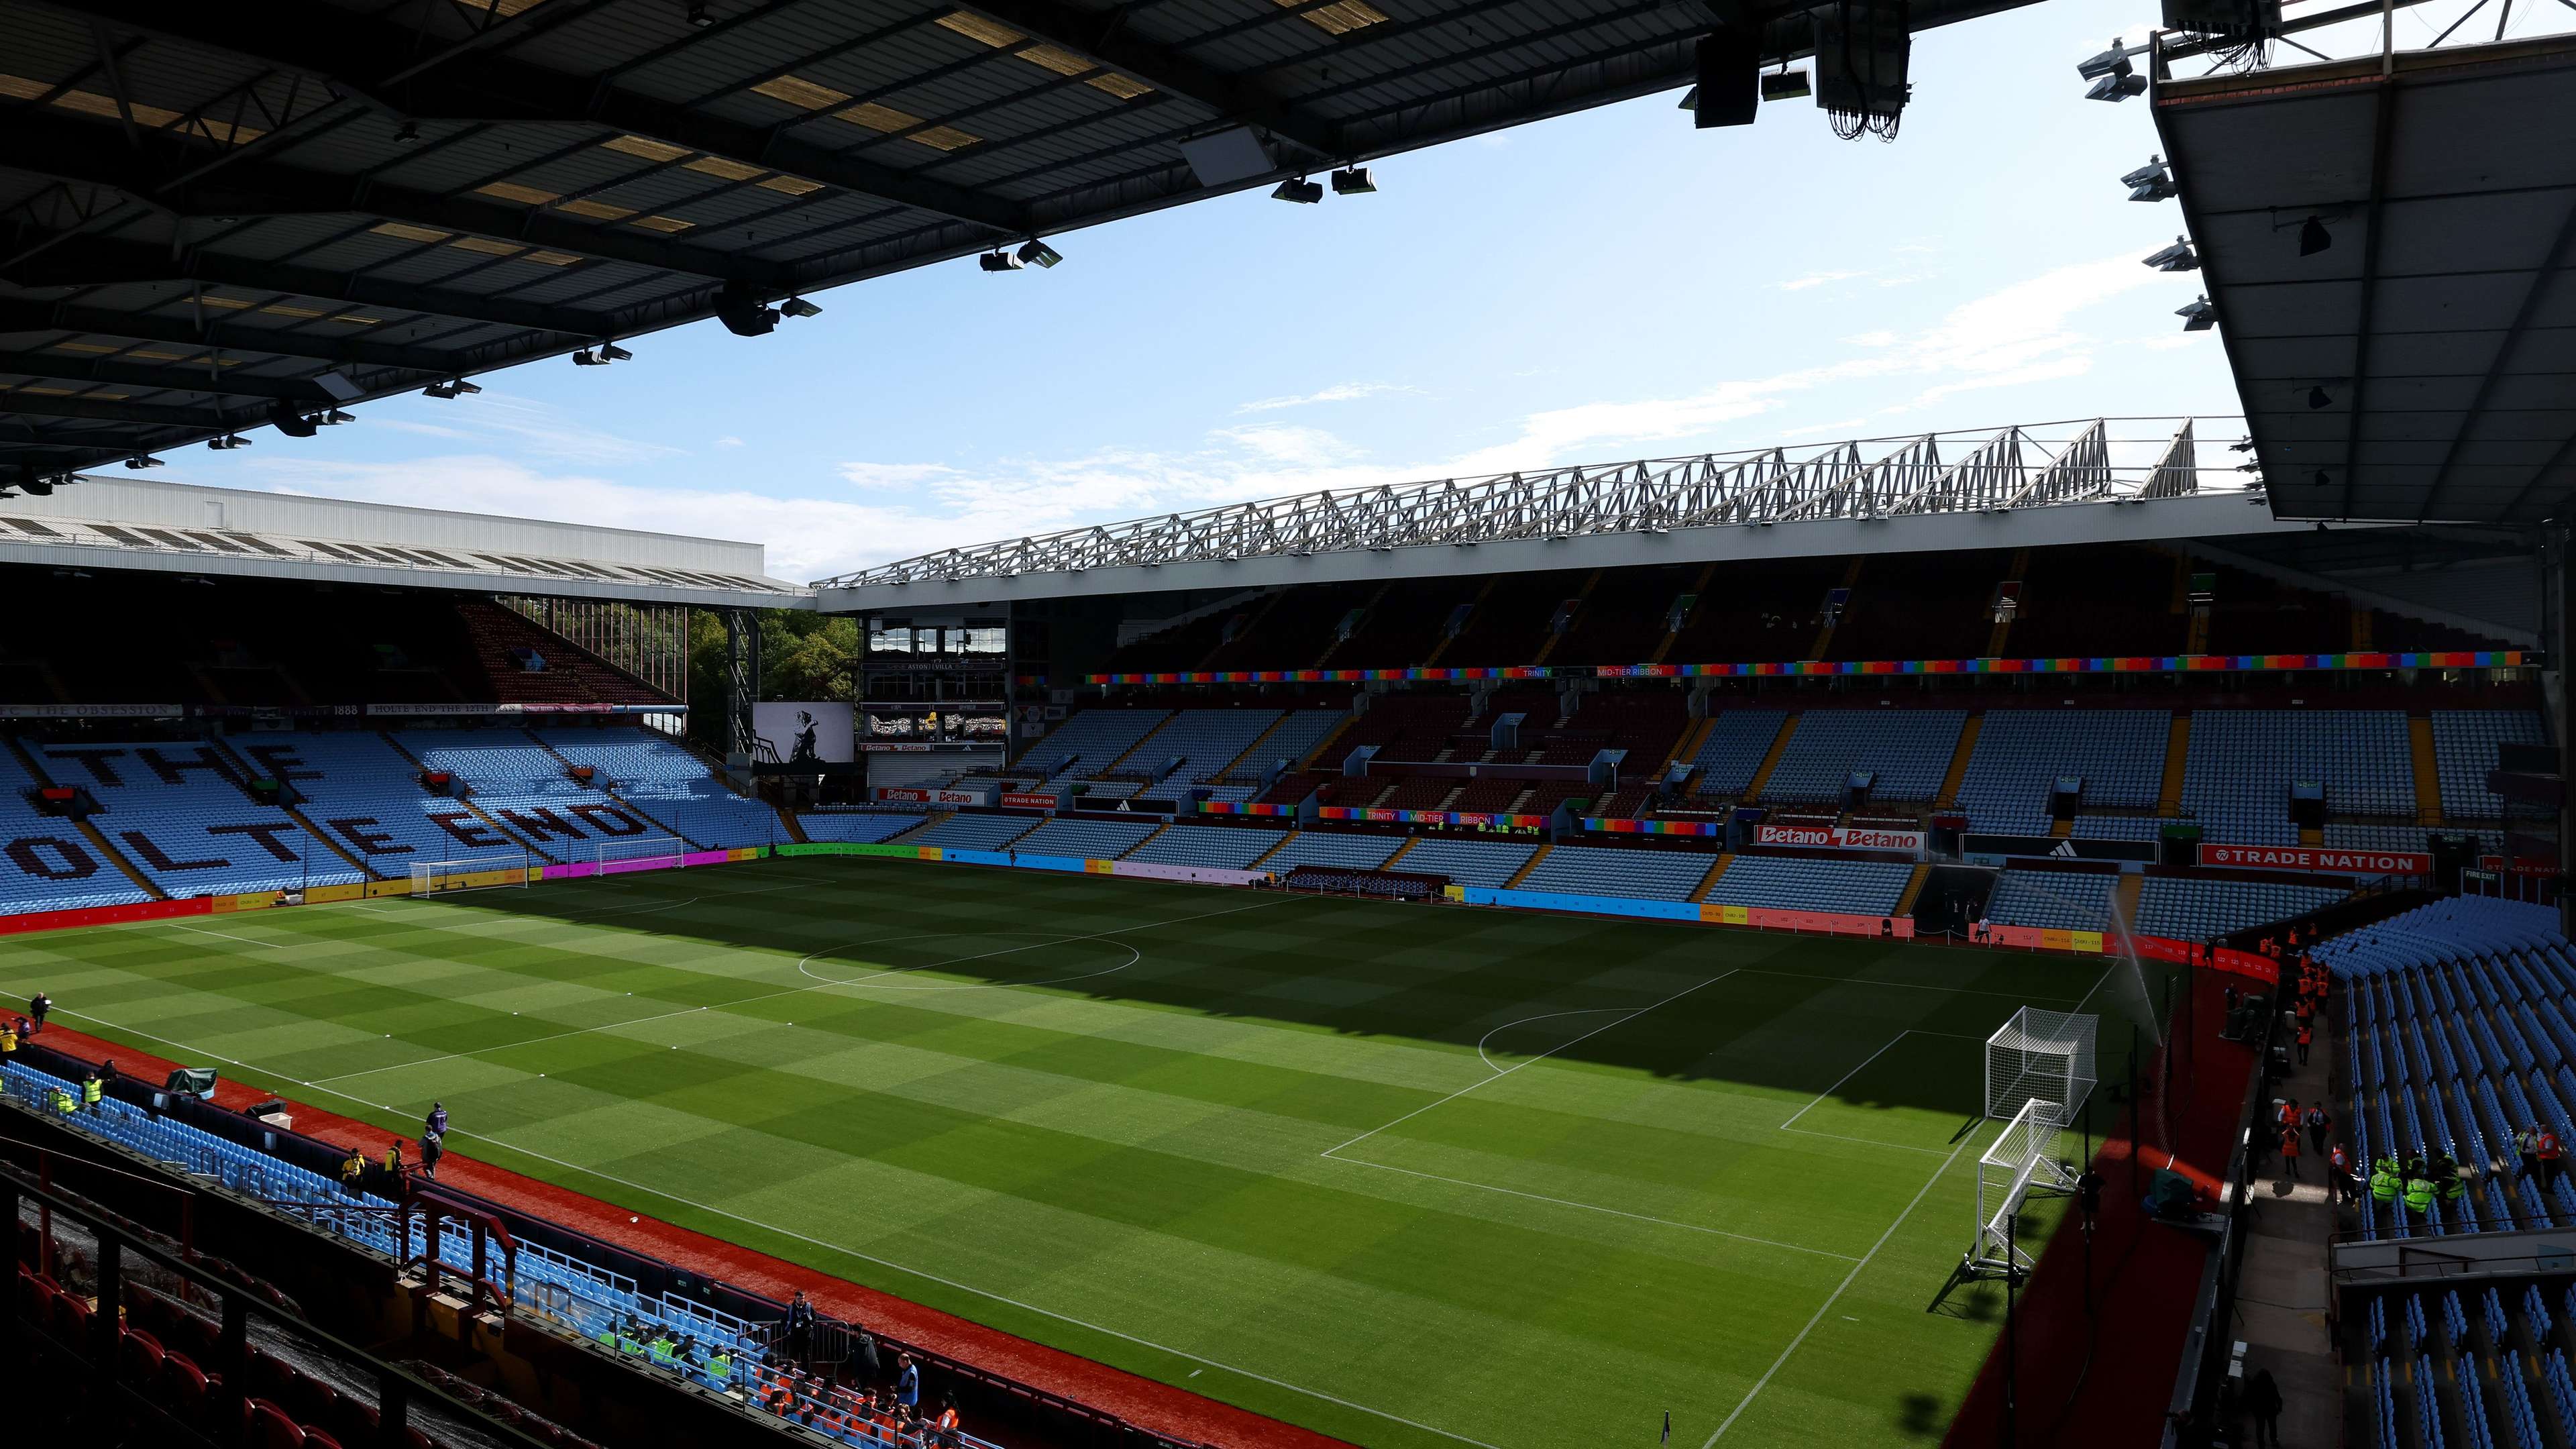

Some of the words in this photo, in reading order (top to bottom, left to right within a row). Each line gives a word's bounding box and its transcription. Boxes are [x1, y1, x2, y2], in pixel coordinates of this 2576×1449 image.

[35, 707, 69, 715] THE
[76, 706, 168, 715] OBSESSION
[334, 705, 358, 715] 1888
[466, 704, 490, 712] 12TH
[43, 745, 326, 793] THE
[887, 789, 918, 801] Betano
[939, 791, 972, 804] Betano
[1366, 812, 1395, 820] TRINITY
[1410, 814, 1444, 822] MID-TIER
[1460, 816, 1491, 824] RIBBON
[425, 804, 648, 848] END
[1760, 826, 1828, 845] Betano
[1846, 830, 1917, 848] Betano
[2233, 850, 2310, 865] TRADE
[2319, 853, 2414, 870] NATION
[2466, 870, 2480, 878] FIRE
[2481, 872, 2496, 880] EXIT
